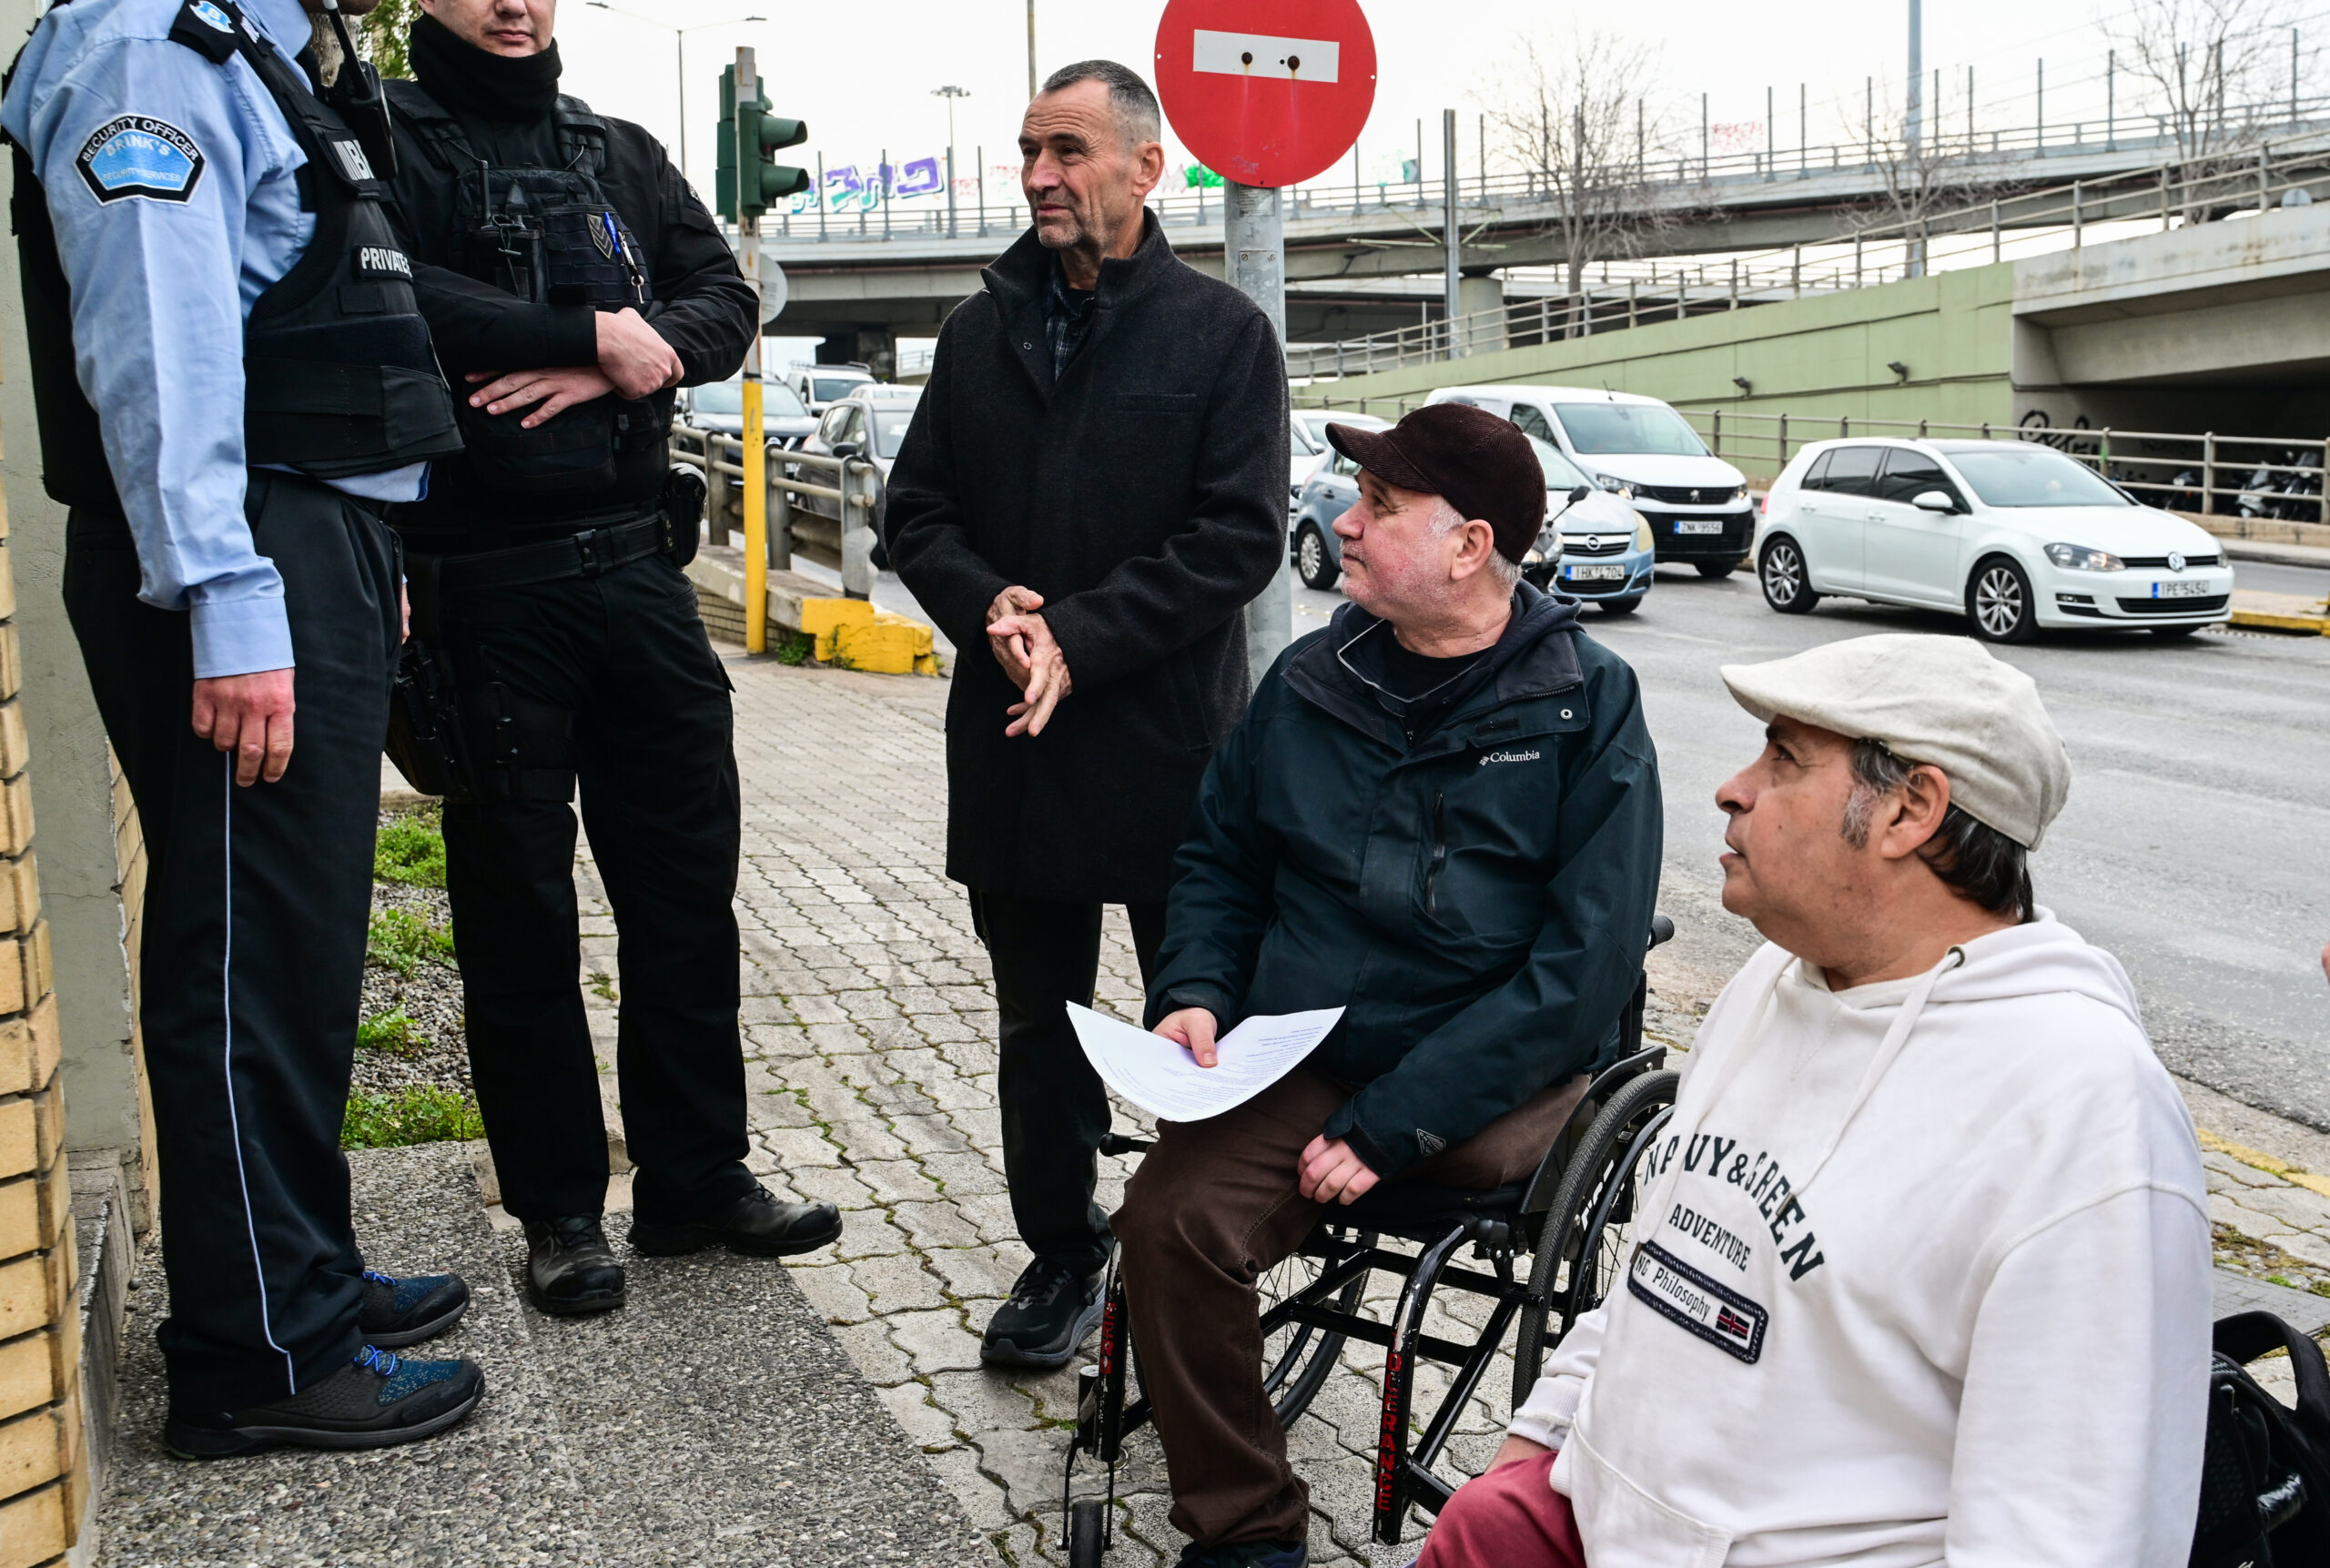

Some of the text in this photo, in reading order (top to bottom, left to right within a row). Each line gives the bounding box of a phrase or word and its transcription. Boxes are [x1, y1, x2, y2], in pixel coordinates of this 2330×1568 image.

[105, 134, 171, 157] BRINK'S
[142, 119, 199, 161] OFFICER
[1490, 750, 1540, 763] Columbia
[1668, 1203, 1751, 1272] ADVENTURE
[1653, 1267, 1711, 1322] Philosophy
